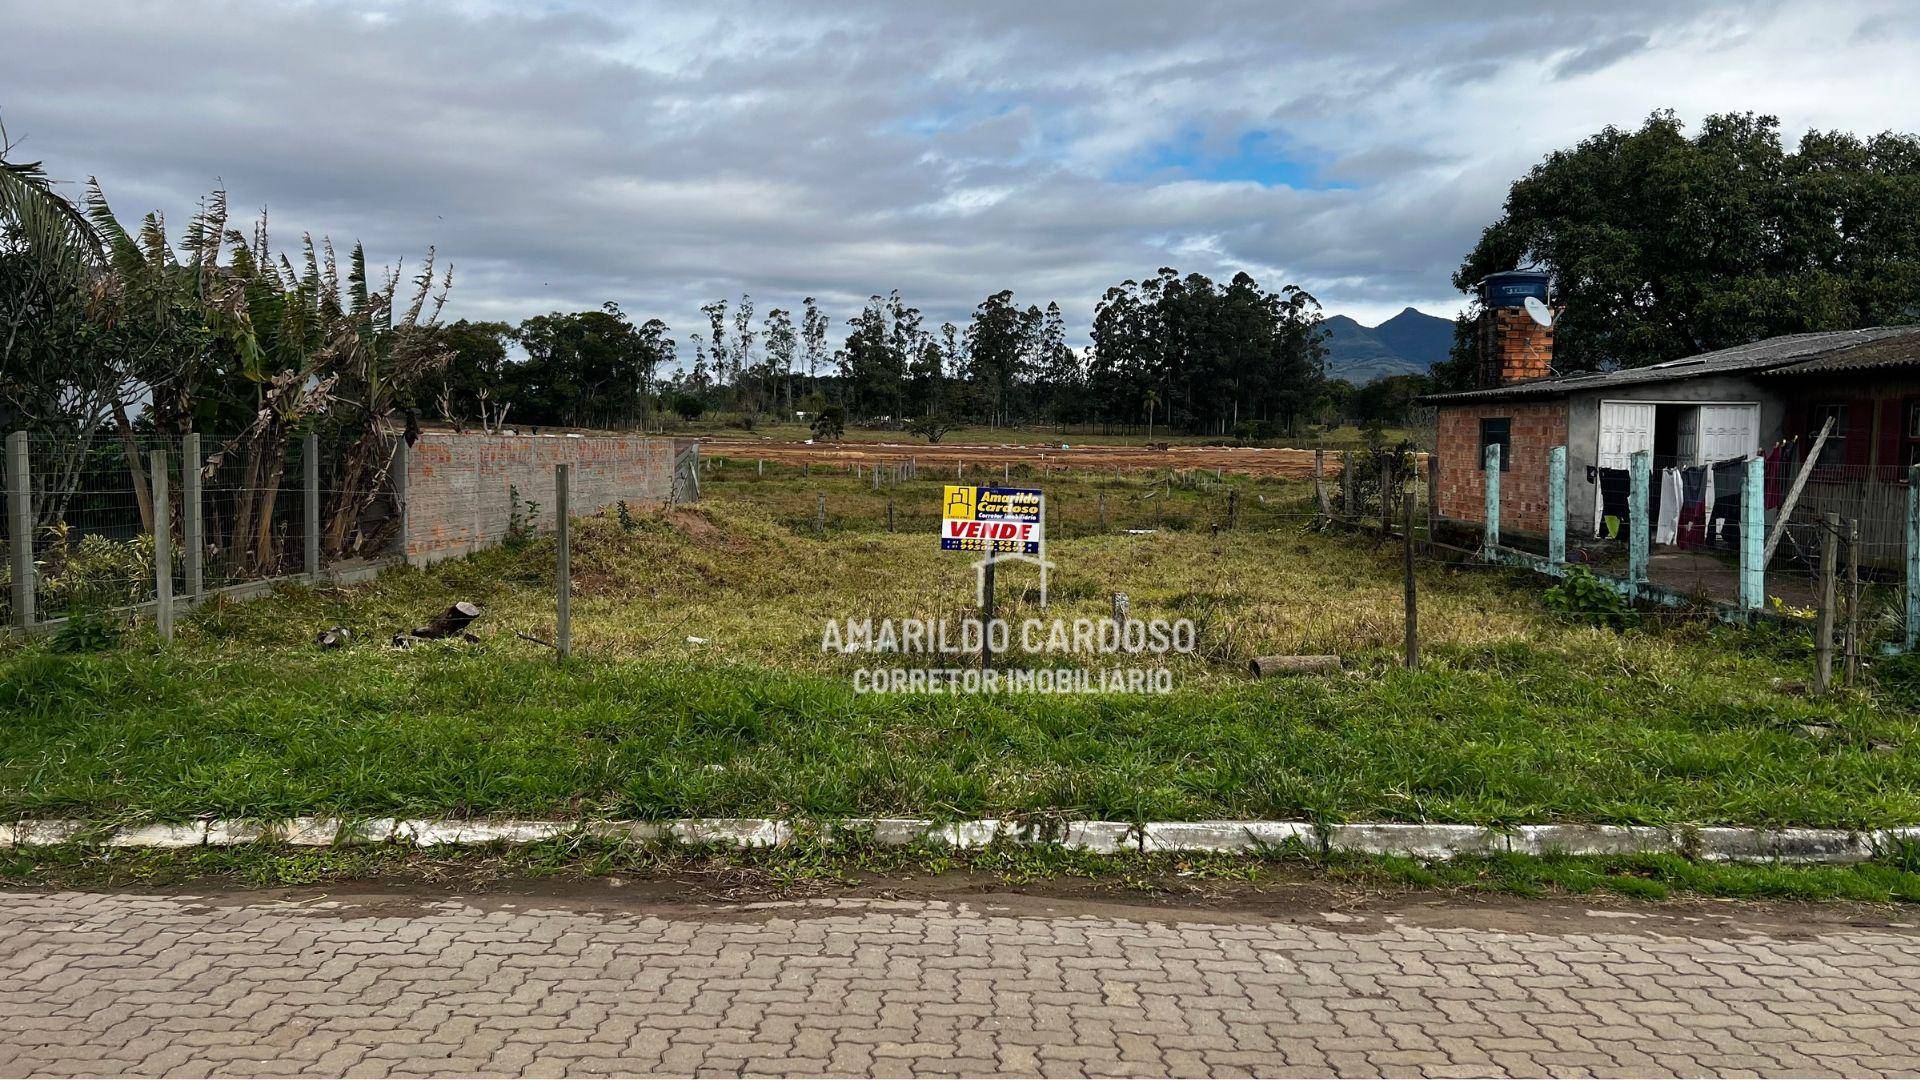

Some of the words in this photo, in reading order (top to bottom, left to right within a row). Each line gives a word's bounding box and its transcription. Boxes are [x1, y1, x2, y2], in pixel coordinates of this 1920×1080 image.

[981, 491, 1039, 504] Amarildo
[977, 502, 1038, 513] Cardoso
[951, 521, 1032, 540] VENDE
